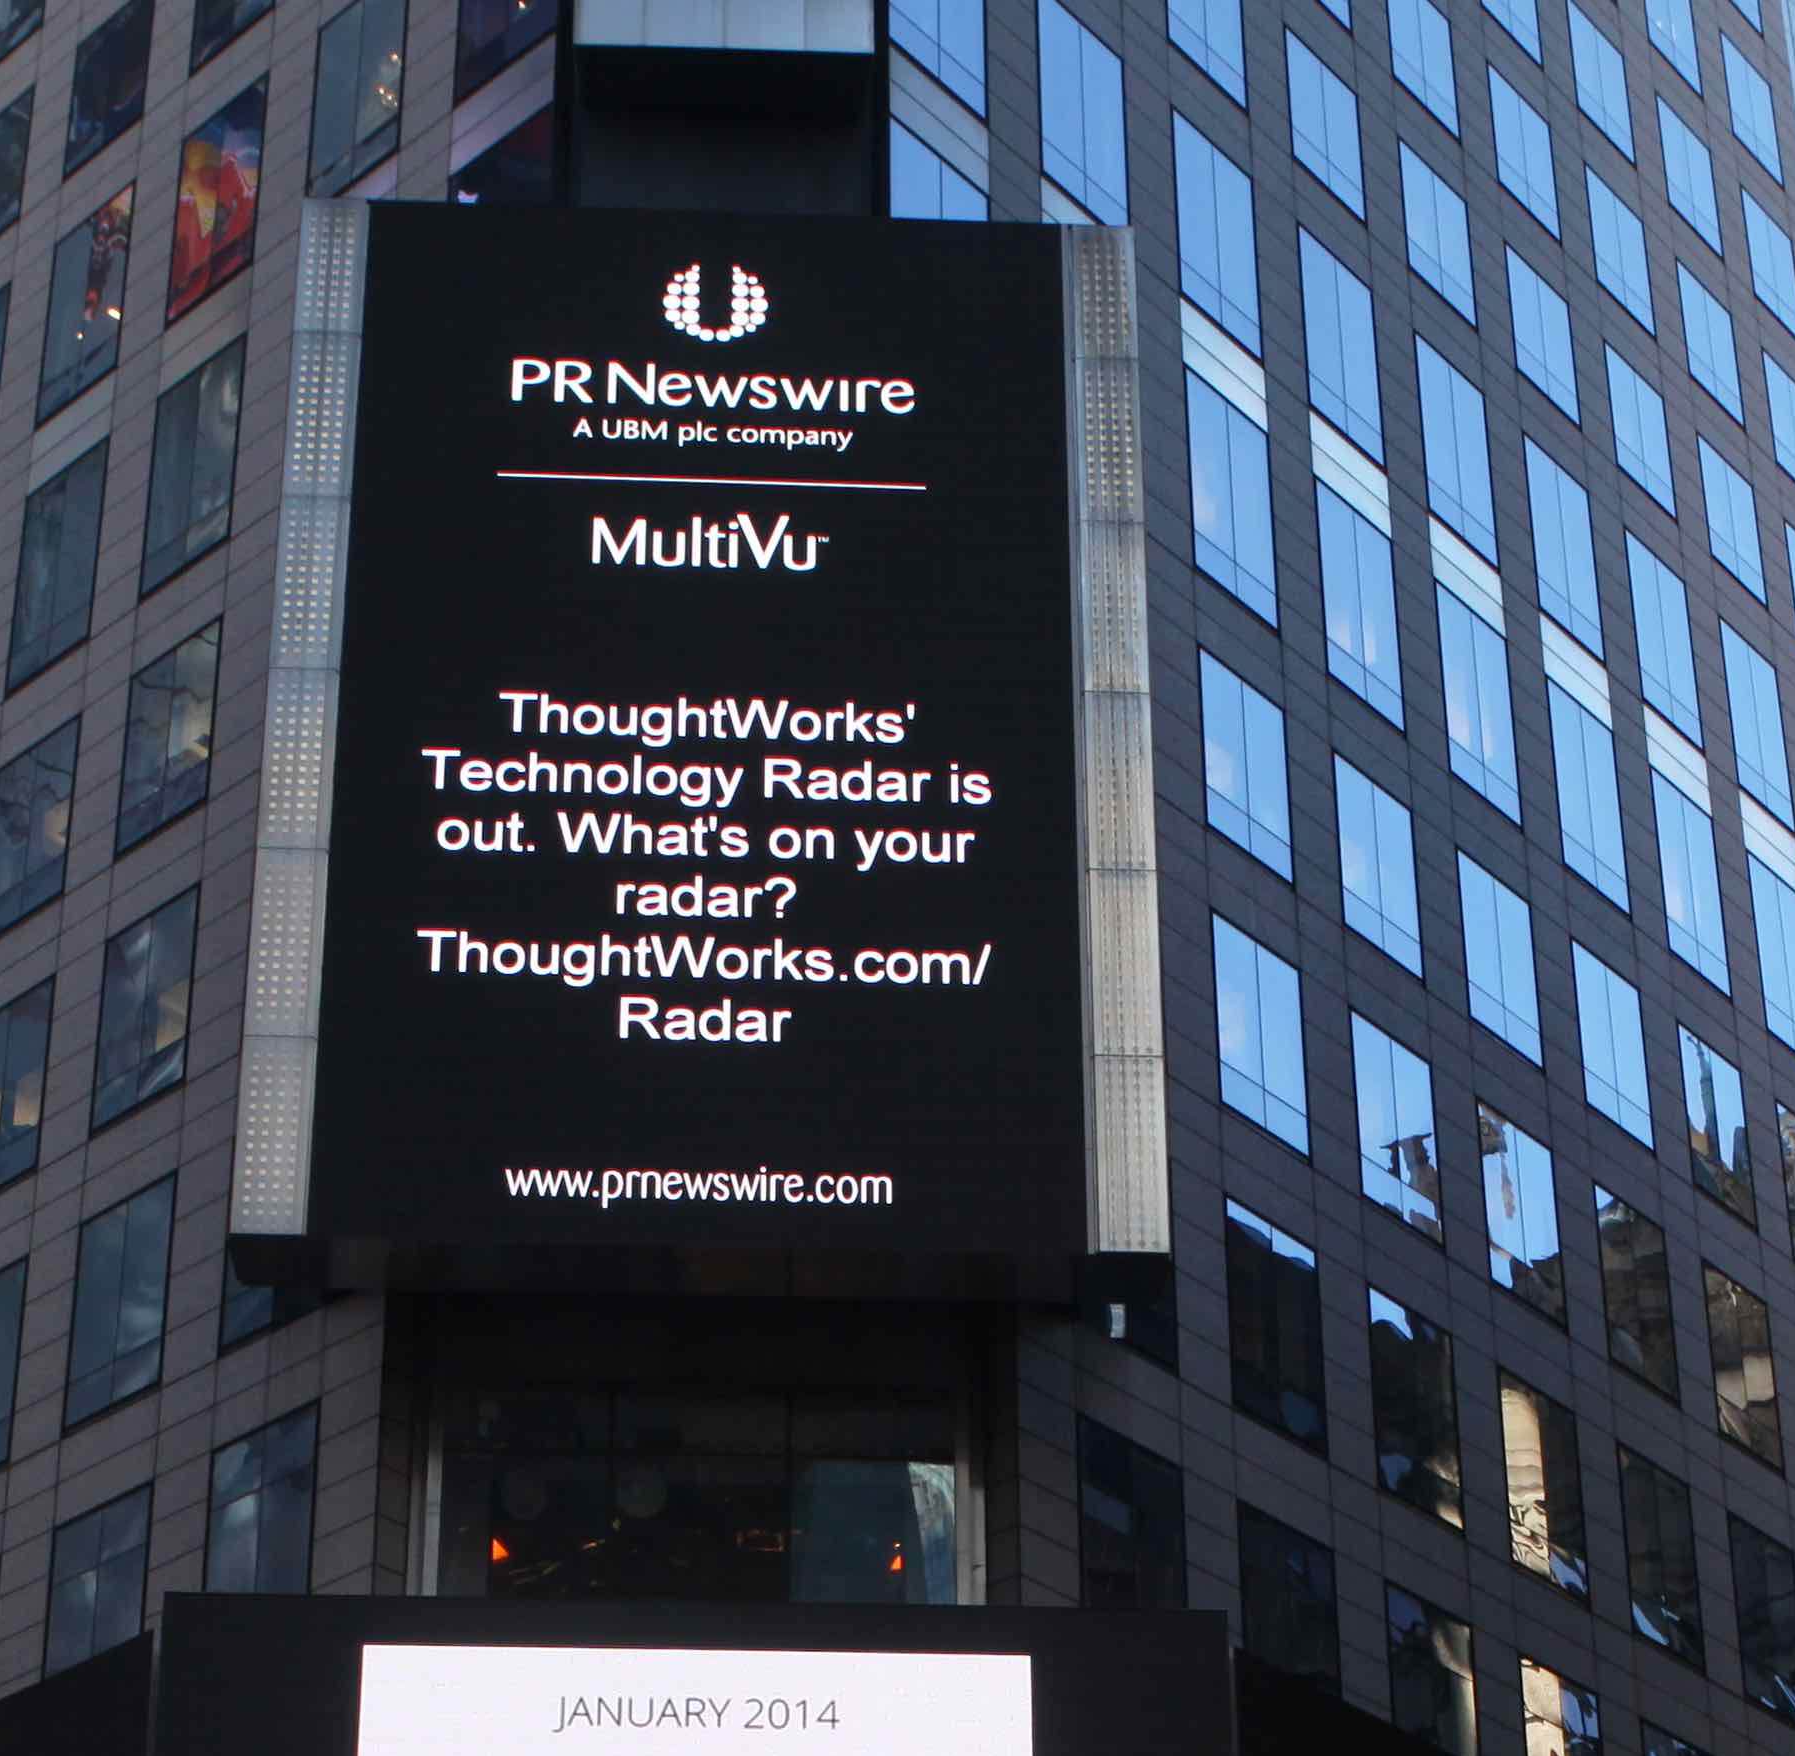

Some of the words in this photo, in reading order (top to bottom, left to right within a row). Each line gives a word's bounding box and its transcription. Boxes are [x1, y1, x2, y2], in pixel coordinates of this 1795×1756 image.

[509, 356, 595, 405] PR
[604, 359, 916, 415] Newswire
[571, 414, 595, 440] A
[601, 416, 669, 444] UBM
[677, 421, 720, 450] plc
[725, 427, 855, 454] company
[499, 691, 916, 747] ThoughtWorks'
[422, 748, 744, 807] Technology
[763, 757, 931, 803] Radar
[949, 763, 993, 804] is
[436, 811, 536, 853] out.
[557, 812, 750, 858] What's
[768, 826, 836, 860] on
[854, 829, 975, 871] your
[615, 876, 797, 919] radar?
[417, 929, 992, 987] ThoughtWorks.com/
[618, 995, 793, 1043] Radar
[504, 1165, 893, 1209] www.prnewswire.com
[552, 1696, 731, 1733] JANUARY
[743, 1698, 840, 1730] 2014
